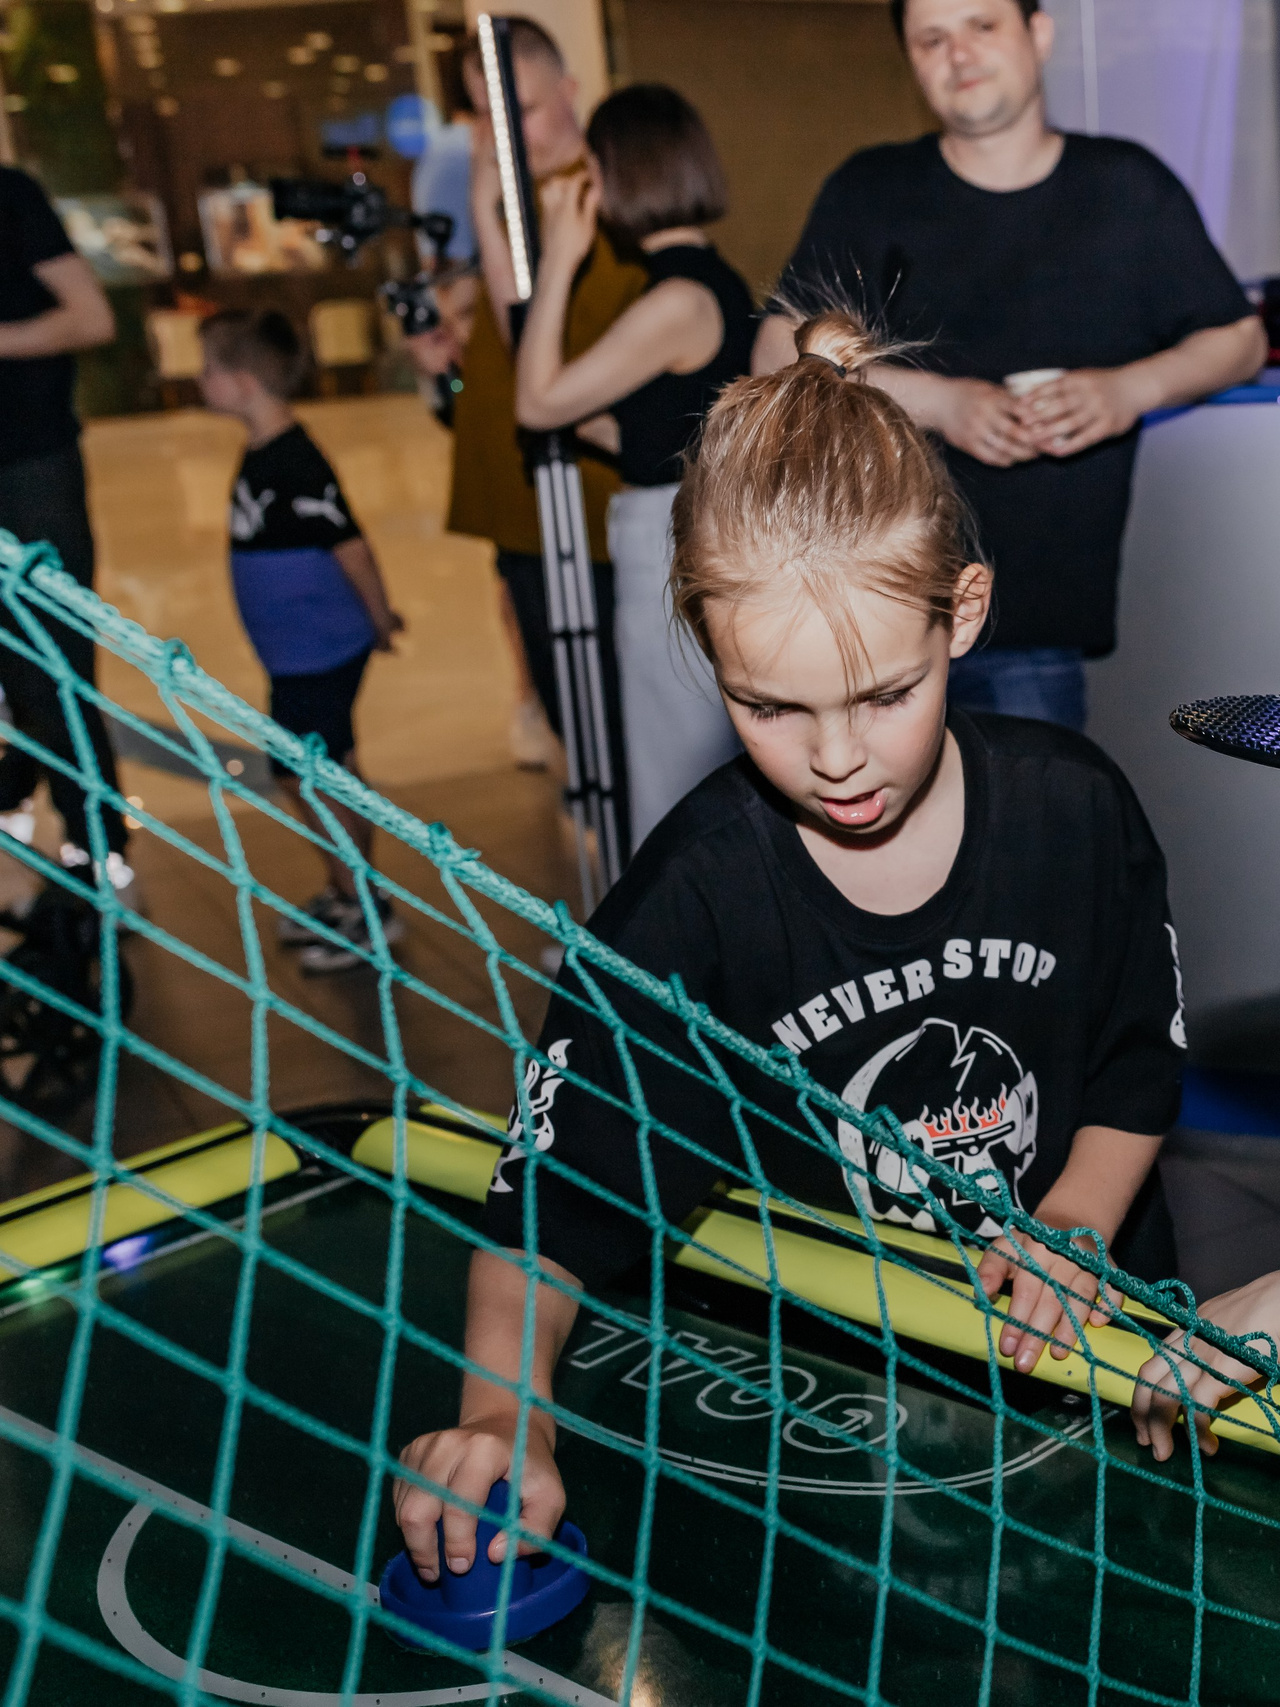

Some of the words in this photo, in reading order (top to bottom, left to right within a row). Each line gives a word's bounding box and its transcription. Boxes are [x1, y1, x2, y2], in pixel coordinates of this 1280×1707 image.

[771, 958, 936, 1055] NEVER
[943, 938, 1057, 988] STOP
[569, 1309, 909, 1454] GOAL
